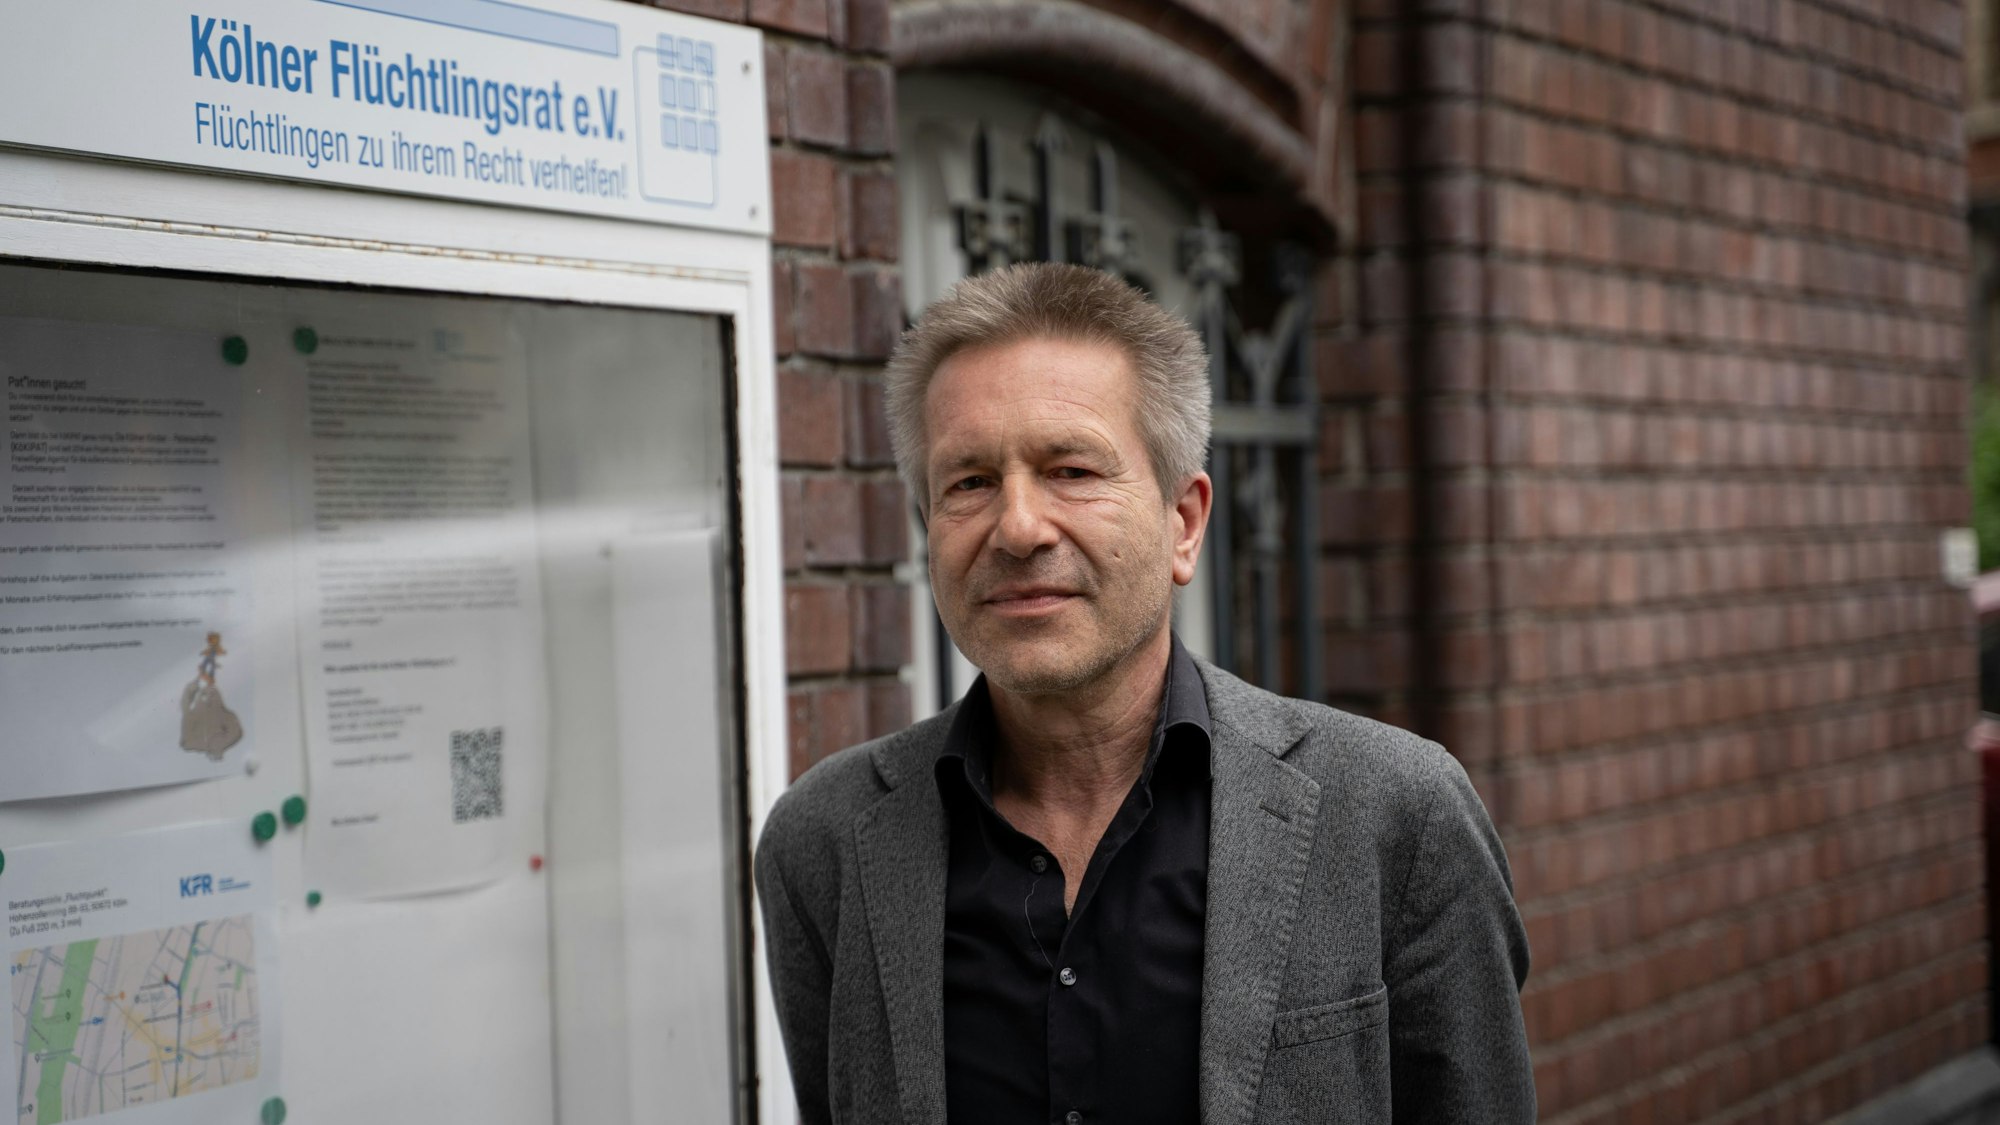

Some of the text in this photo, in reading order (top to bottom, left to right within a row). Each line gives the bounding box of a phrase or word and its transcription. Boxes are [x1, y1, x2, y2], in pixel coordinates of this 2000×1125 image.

[191, 14, 624, 142] Kölner Flüchtlingsrat e.V.
[195, 102, 627, 200] Flüchtlingen zu ihrem Recht verhelfen!
[180, 874, 213, 898] KFR
